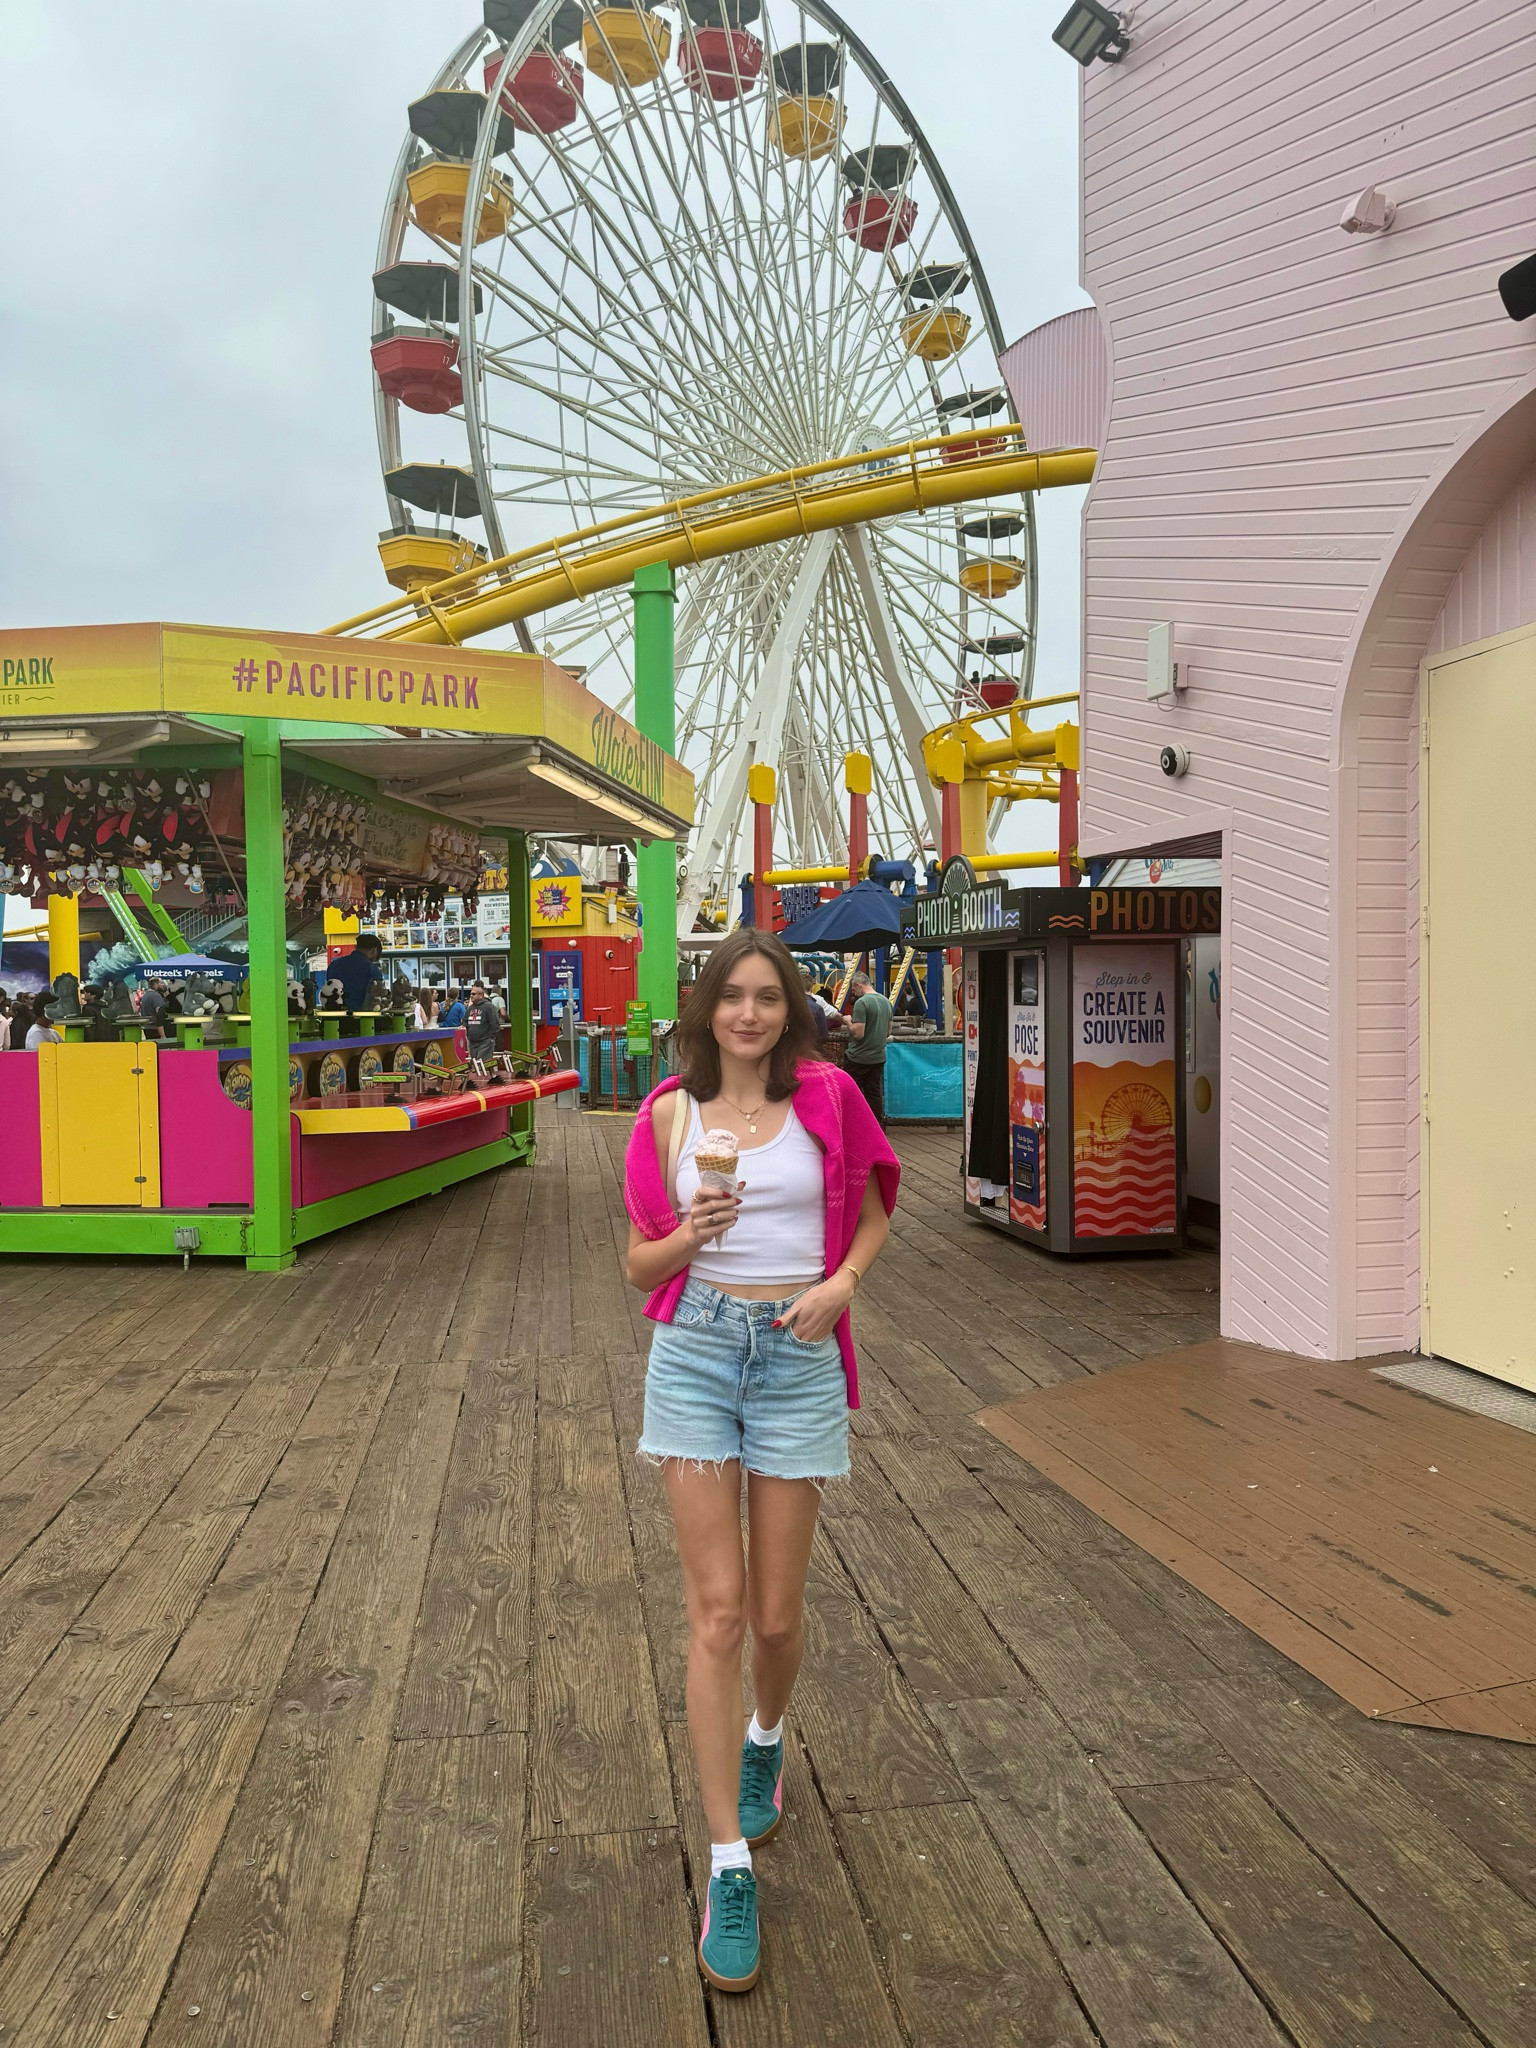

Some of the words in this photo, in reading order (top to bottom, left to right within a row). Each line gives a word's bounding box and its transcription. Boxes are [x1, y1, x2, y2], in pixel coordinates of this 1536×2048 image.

[551, 70, 558, 80] 15
[3, 657, 54, 686] PARK
[232, 658, 480, 710] #PACIFICPARK
[2, 694, 20, 705] IER
[781, 887, 819, 905] PACIFIC
[917, 896, 950, 937] PHOTO
[962, 886, 1002, 932] BOOTH
[1090, 890, 1220, 931] PHOTOS
[143, 969, 183, 977] Wetzel's
[1096, 971, 1124, 988] Step
[1127, 973, 1139, 984] in
[1142, 972, 1152, 984] &
[1083, 992, 1147, 1016] CREATE
[1154, 991, 1165, 1015] A
[1014, 1024, 1039, 1055] POSE
[1083, 1020, 1165, 1044] SOUVENIR
